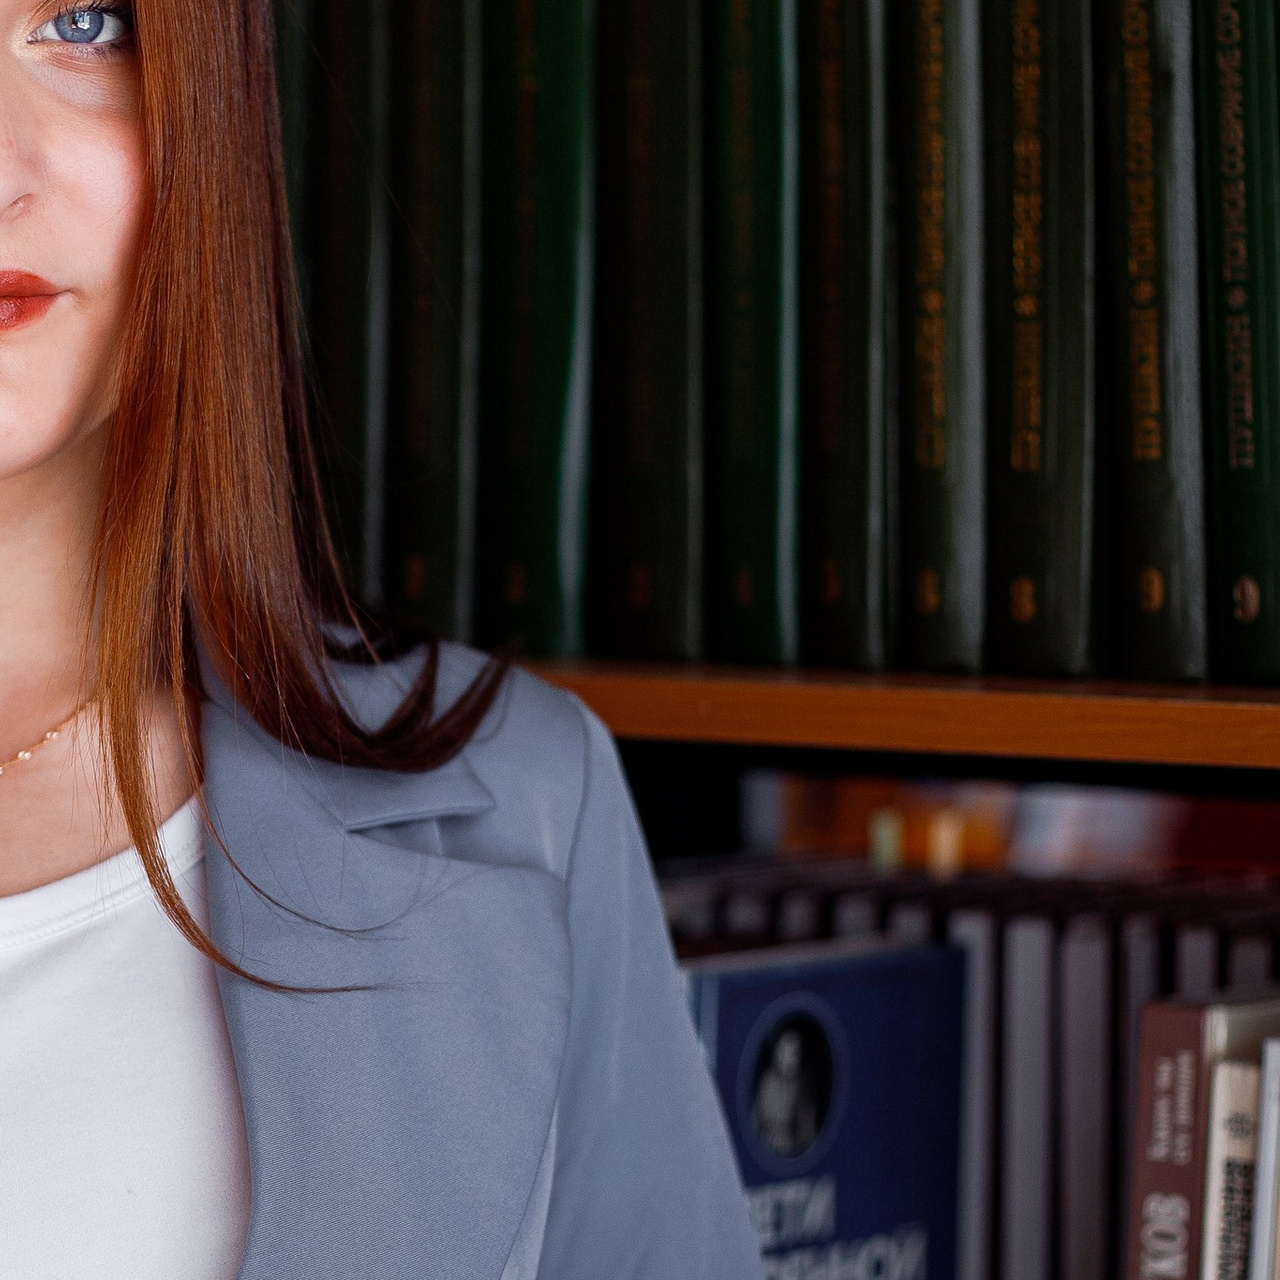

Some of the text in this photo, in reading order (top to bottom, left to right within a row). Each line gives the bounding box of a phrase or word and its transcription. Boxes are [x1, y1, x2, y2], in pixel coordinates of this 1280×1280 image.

[1214, 47, 1244, 174] СОБРАНИЕ
[1126, 174, 1157, 278] ПОЛНОЕ
[1219, 177, 1248, 281] ПОЛНОЕ
[1129, 308, 1162, 461] ПУШКИН
[1224, 314, 1256, 469] ПУШКИН
[746, 1175, 837, 1246] ЕТИ
